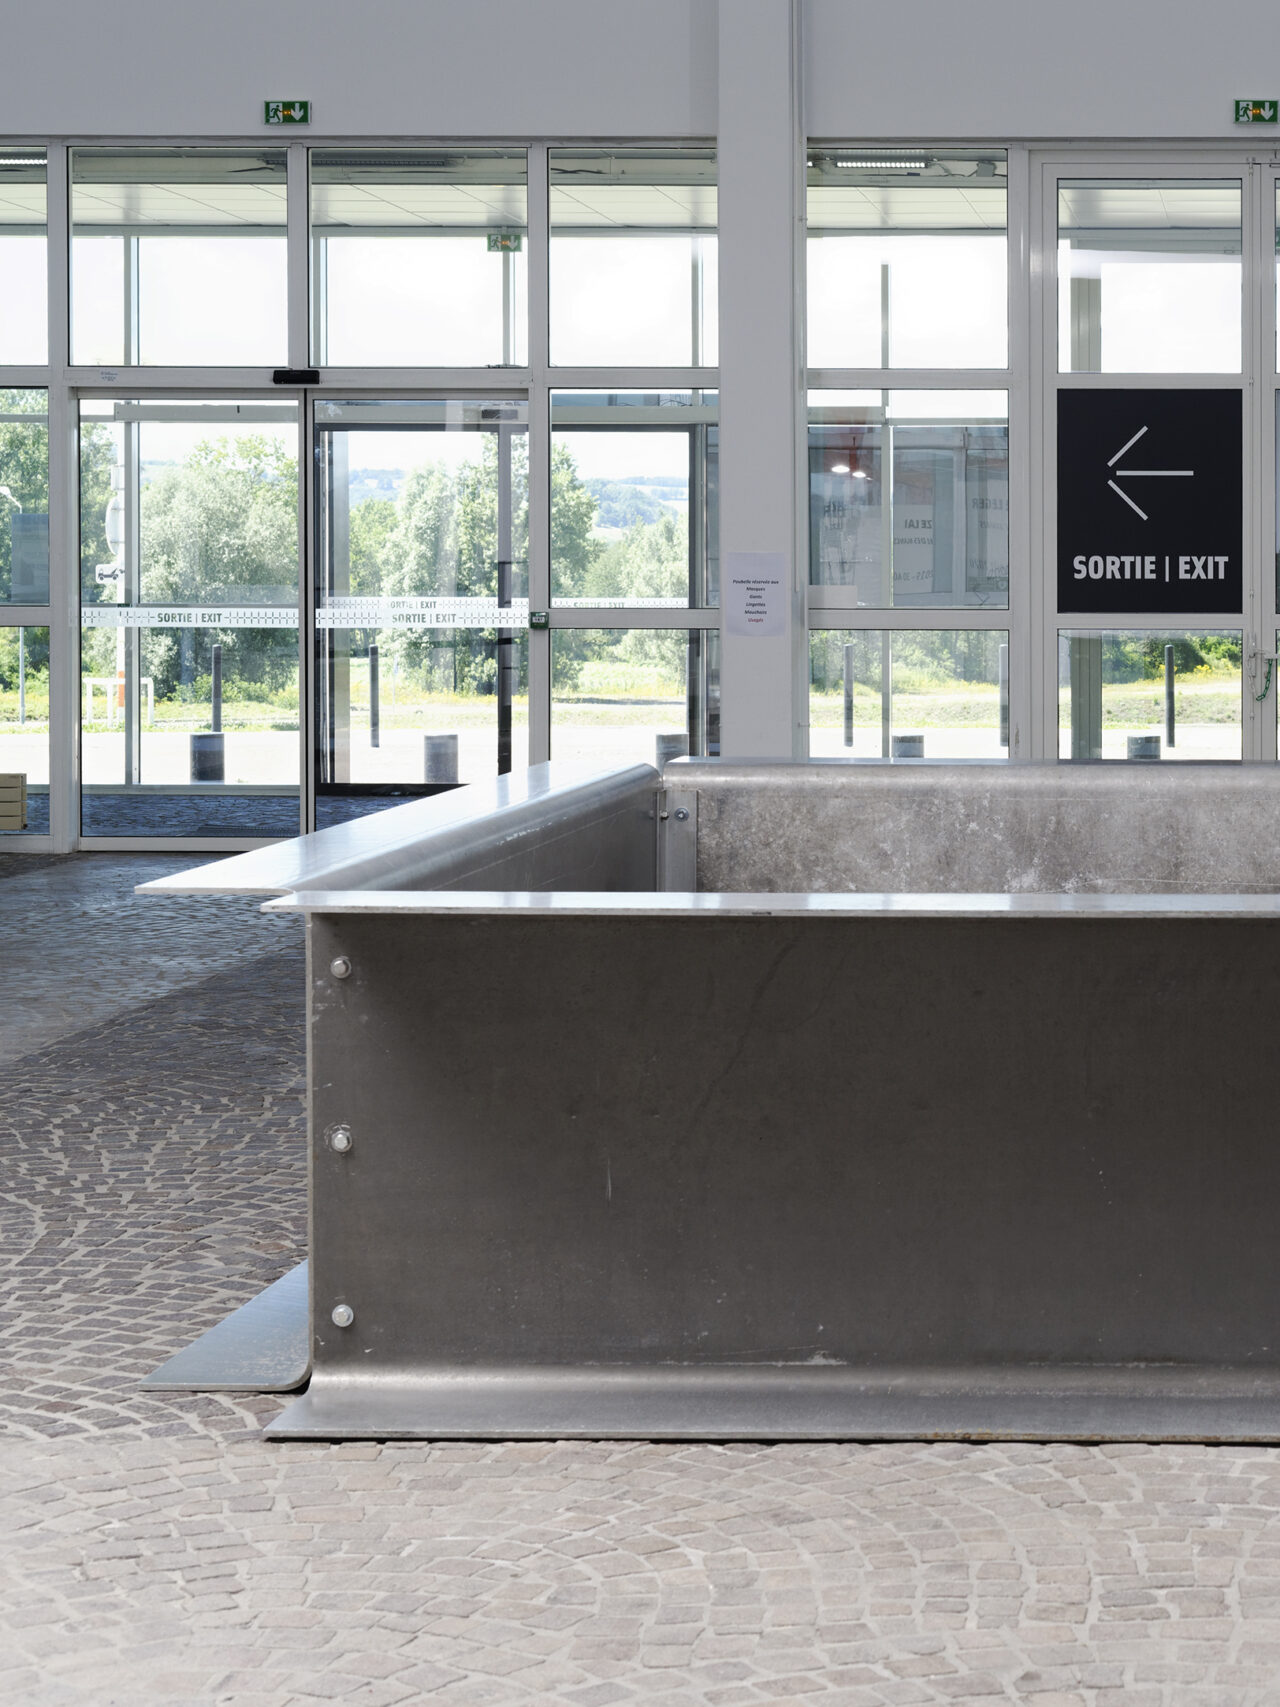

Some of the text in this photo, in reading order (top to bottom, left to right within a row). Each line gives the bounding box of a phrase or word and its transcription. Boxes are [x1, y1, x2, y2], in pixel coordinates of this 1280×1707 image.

[1073, 555, 1156, 579] SORTIE
[1179, 555, 1229, 579] EXIT
[157, 613, 192, 623] SORTIE
[201, 613, 222, 623] EXIT
[392, 613, 426, 623] SORTIE
[435, 613, 456, 623] EXIT
